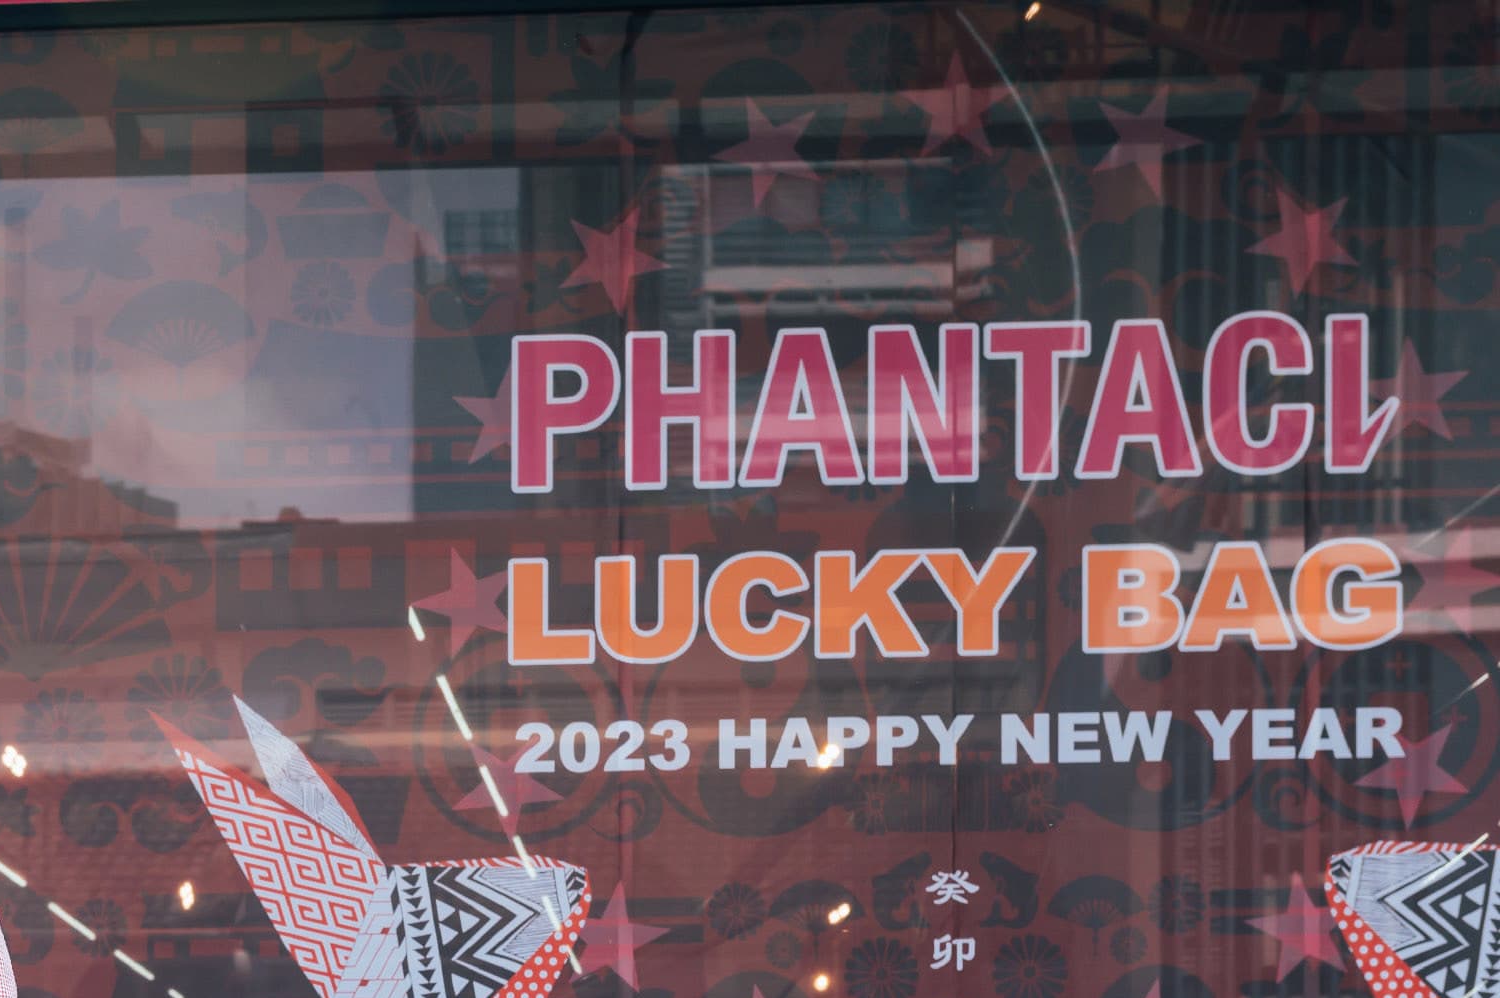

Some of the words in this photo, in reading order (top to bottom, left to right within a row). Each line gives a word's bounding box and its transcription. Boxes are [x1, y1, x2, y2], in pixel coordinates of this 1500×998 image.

[507, 547, 1037, 666] LUCKY
[1082, 537, 1404, 655] BAG
[514, 719, 691, 773] 2023
[718, 714, 974, 769] HAPPY
[1001, 711, 1172, 764] NEW
[1195, 707, 1405, 761] YEAR
